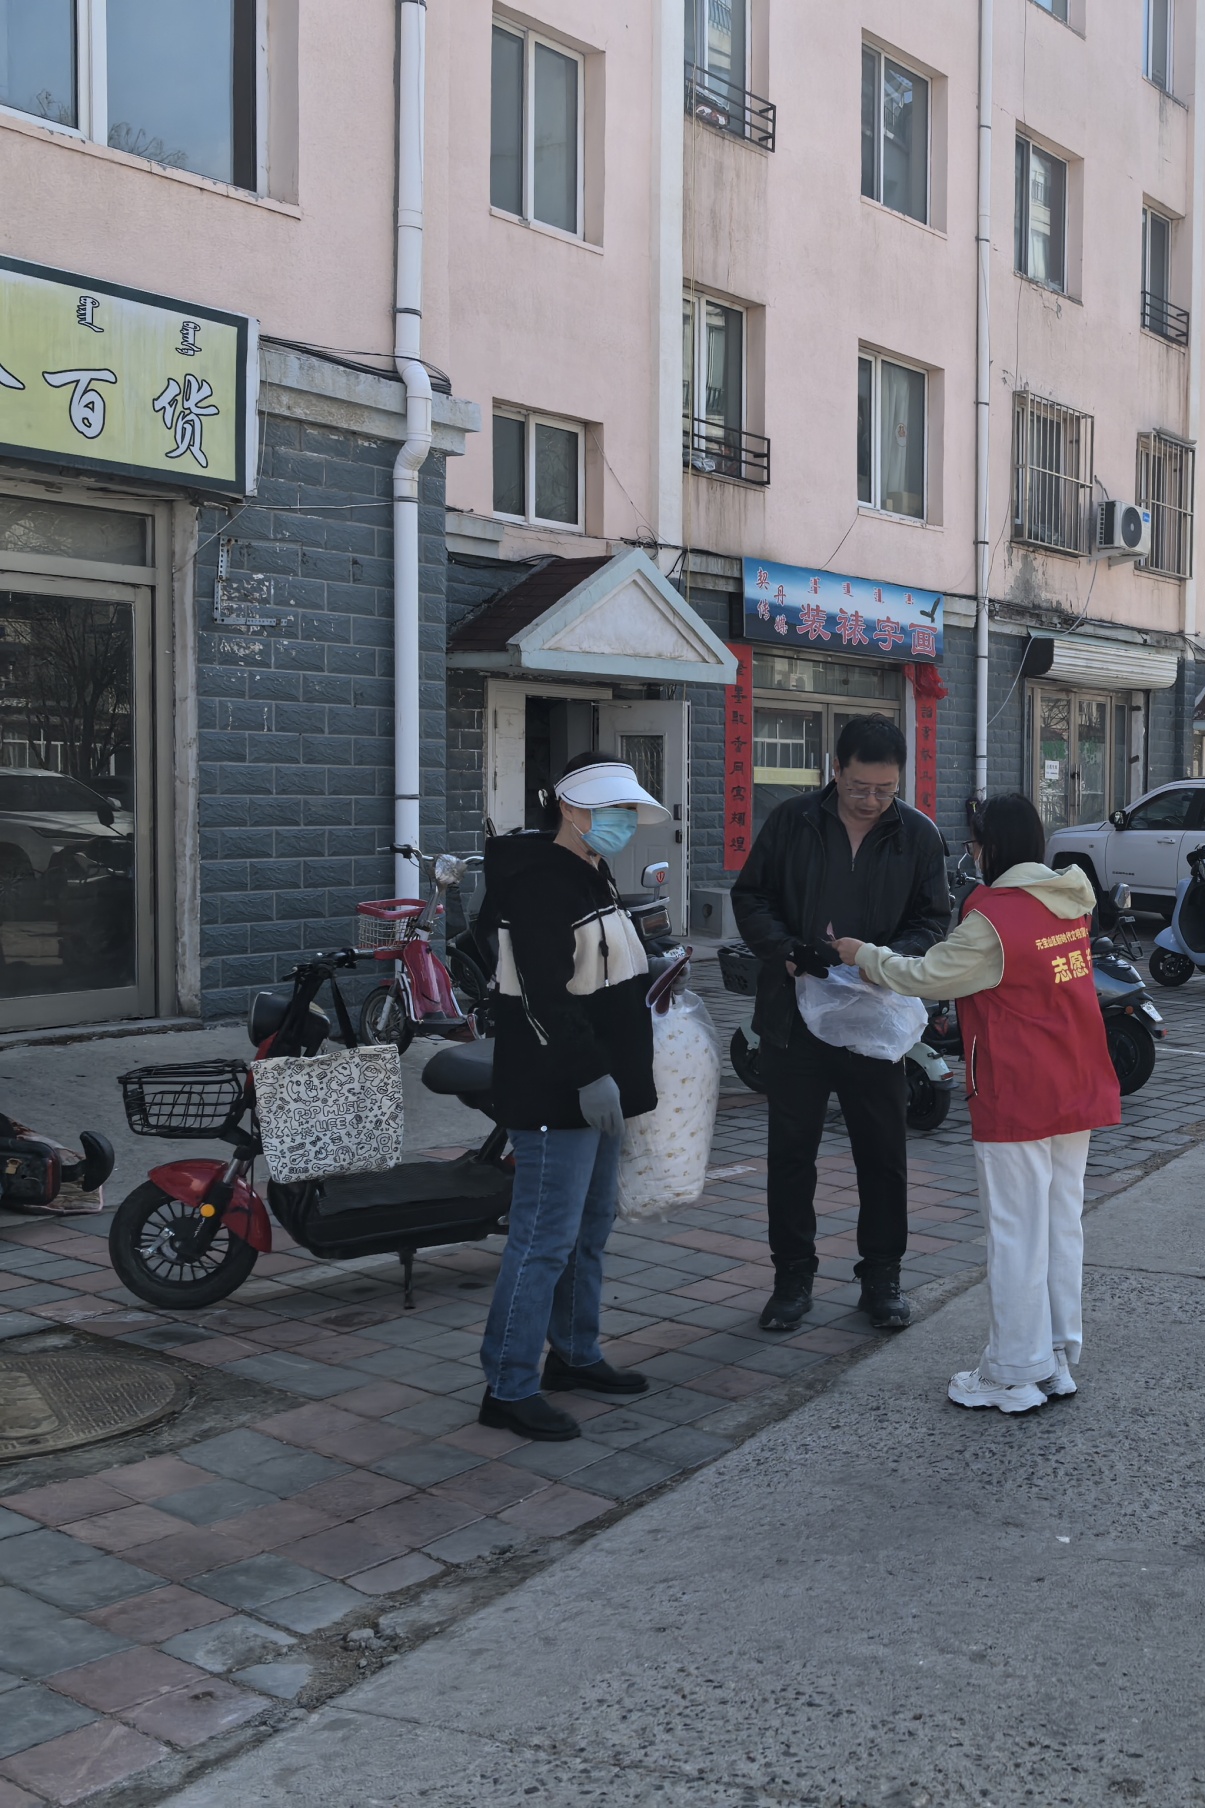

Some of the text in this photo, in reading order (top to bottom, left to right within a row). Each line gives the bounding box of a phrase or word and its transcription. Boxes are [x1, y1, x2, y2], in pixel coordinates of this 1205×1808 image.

[0, 362, 220, 468] 百货
[796, 603, 938, 657] 装裱字画
[1035, 927, 1089, 951] 元宝山区新时代文明实
[322, 1098, 368, 1118] MUSIC
[315, 1116, 347, 1133] LIFE
